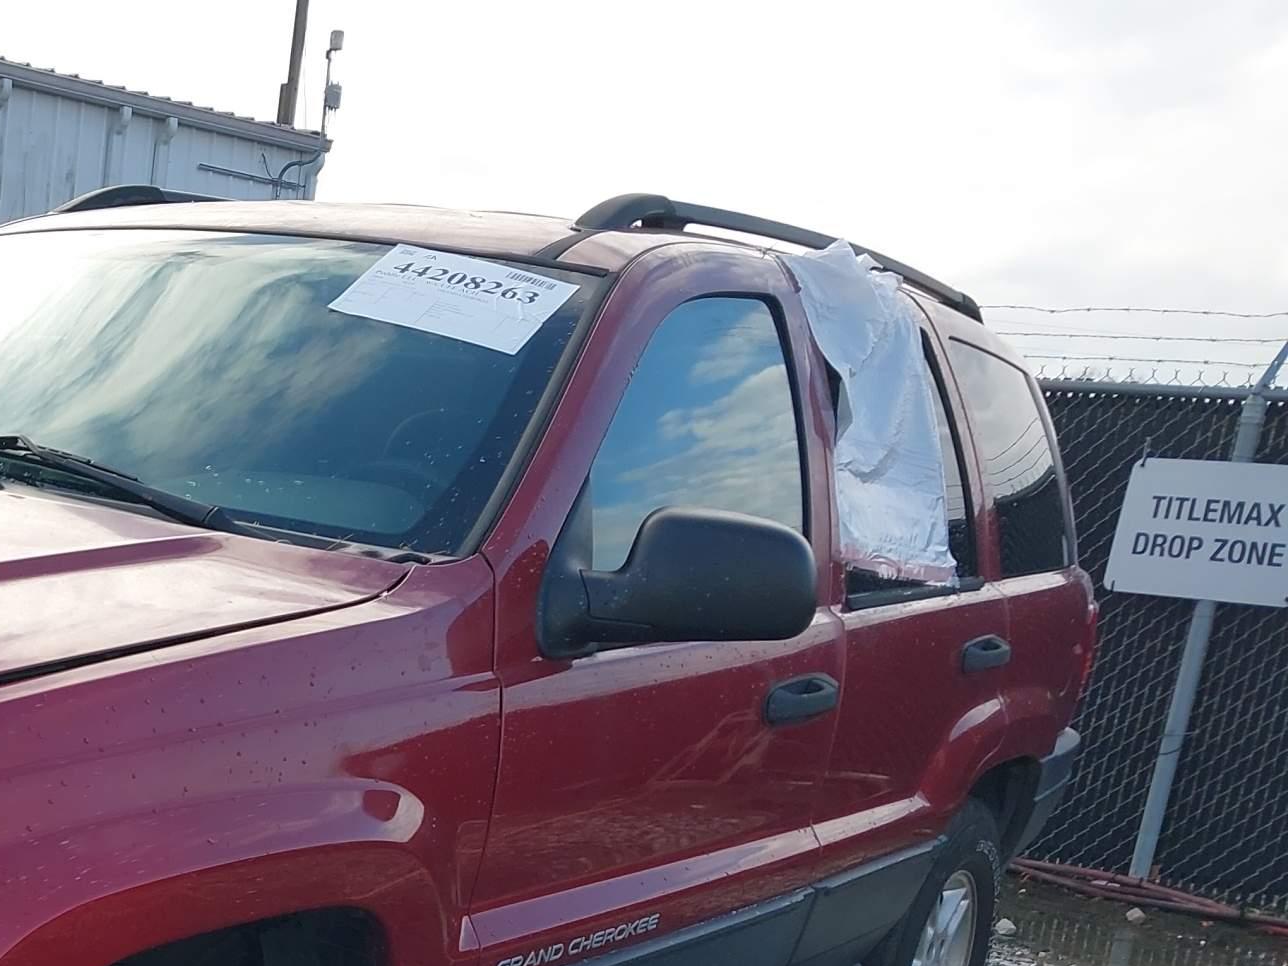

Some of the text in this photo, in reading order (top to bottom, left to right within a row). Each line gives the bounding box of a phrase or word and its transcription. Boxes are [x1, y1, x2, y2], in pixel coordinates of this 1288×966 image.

[393, 262, 540, 305] 44208263
[1152, 495, 1286, 528] TITLEMAX
[1131, 532, 1286, 567] DROP ZONE
[568, 913, 660, 956] CHEROKEE
